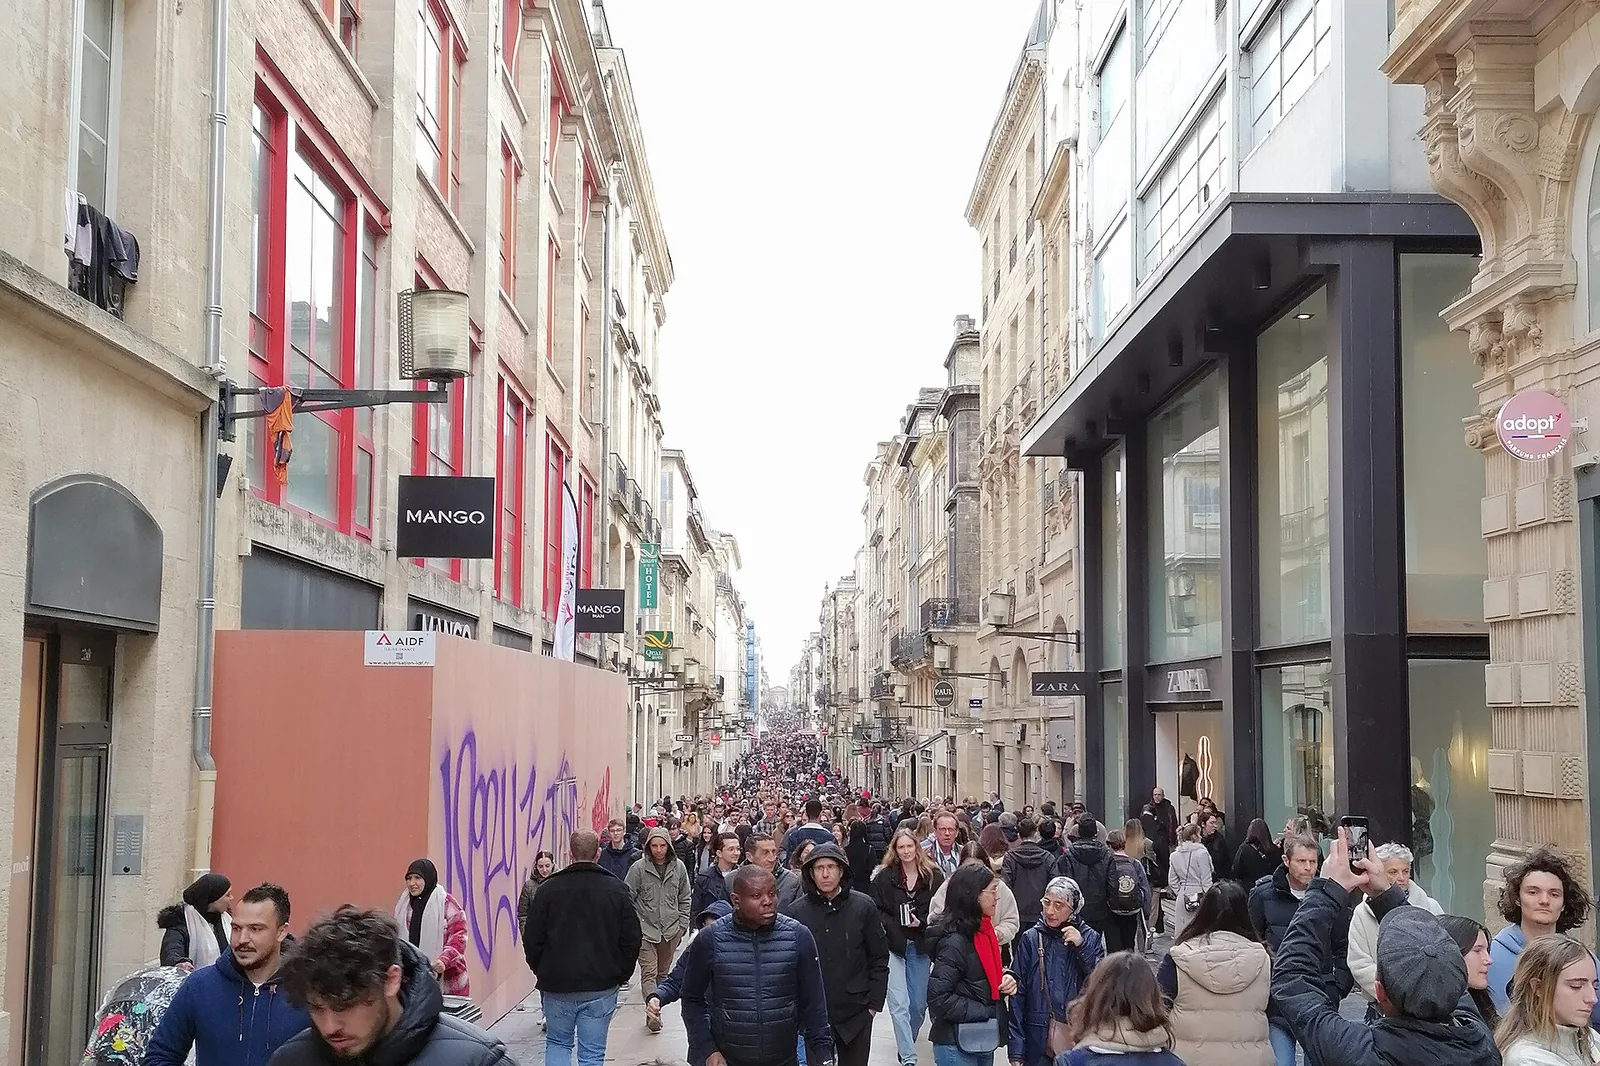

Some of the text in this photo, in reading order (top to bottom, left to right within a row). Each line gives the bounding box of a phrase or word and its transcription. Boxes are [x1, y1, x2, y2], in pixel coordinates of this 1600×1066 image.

[1506, 440, 1534, 459] PARFUMS
[406, 509, 485, 525] MANGO
[645, 567, 653, 606] HOTEL
[577, 605, 621, 614] MANGO
[395, 637, 424, 646] AIDF
[1035, 682, 1081, 692] ZARA
[1167, 668, 1211, 693] ZARA
[935, 688, 953, 696] PAUL
